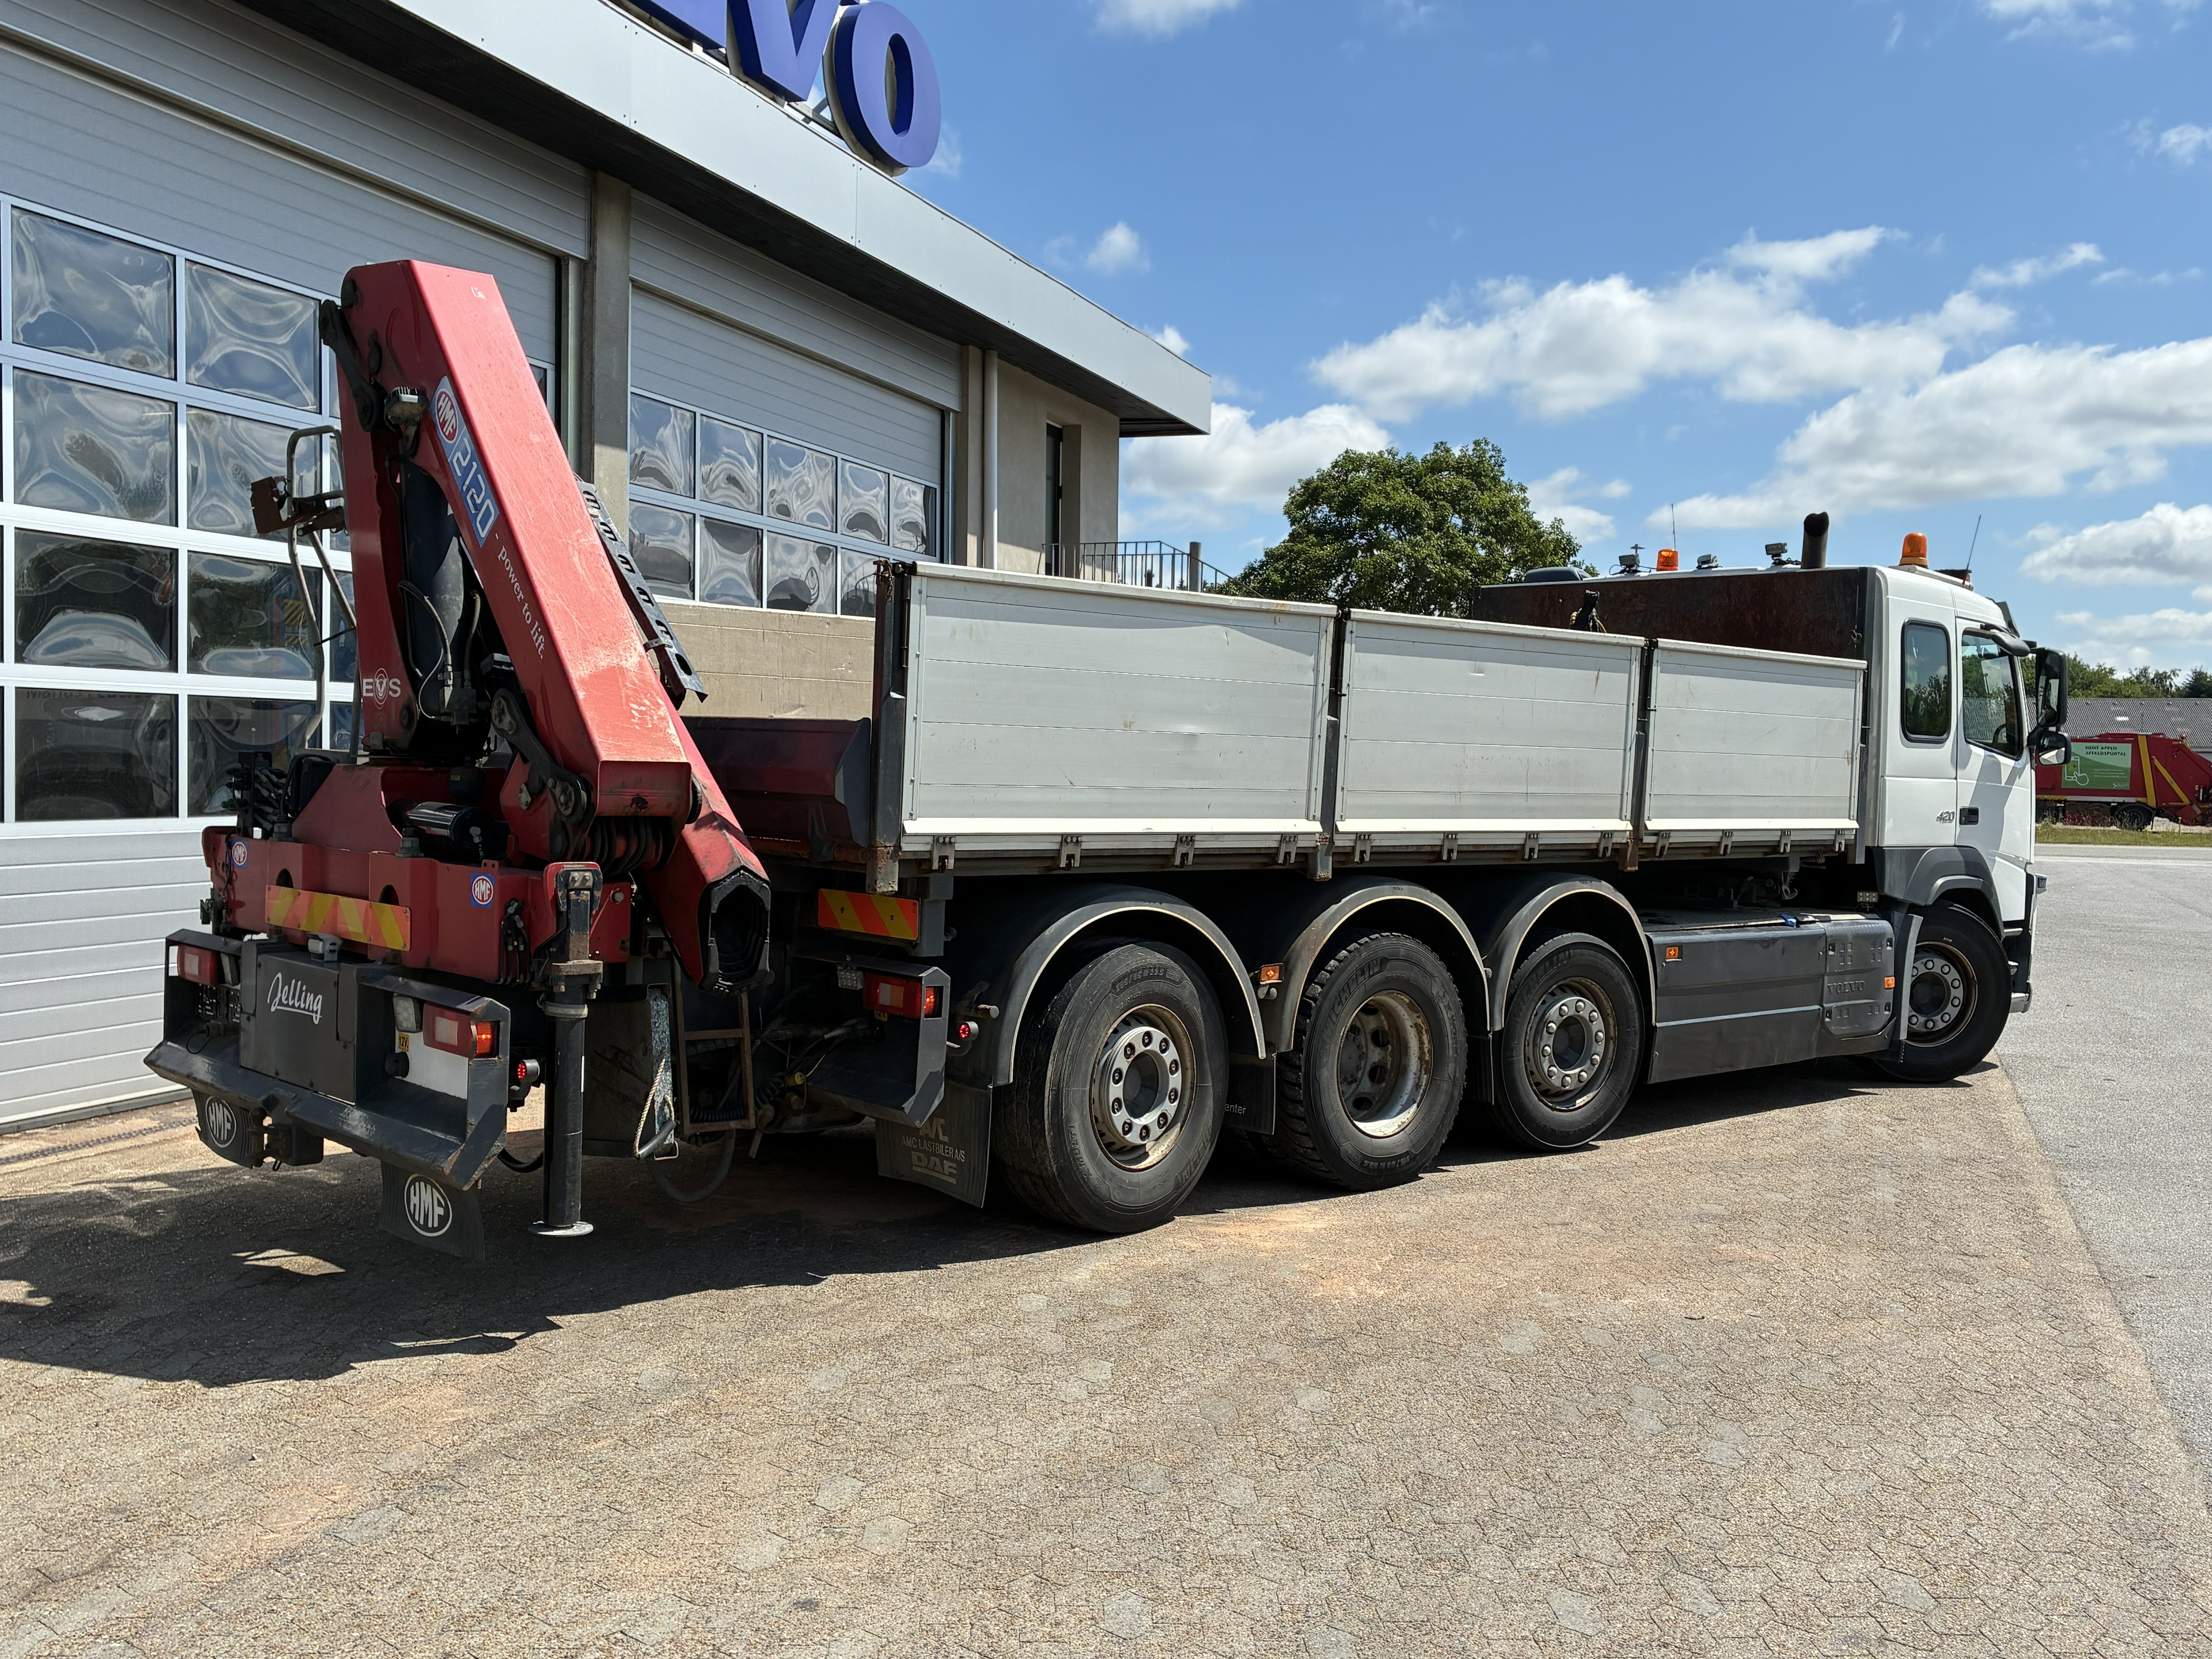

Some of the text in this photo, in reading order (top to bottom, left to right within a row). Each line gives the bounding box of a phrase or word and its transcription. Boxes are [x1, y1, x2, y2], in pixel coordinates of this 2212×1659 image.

[629, 0, 941, 168] VO
[437, 394, 456, 435] HMF
[453, 438, 494, 538] 2120
[498, 545, 524, 602] power
[522, 602, 532, 624] to
[530, 621, 545, 659] lift.
[1936, 810, 1955, 823] 420
[234, 844, 245, 862] HMF
[475, 879, 490, 901] HMF
[267, 972, 323, 1025] Jelling
[1827, 980, 1865, 994] VOLVO
[208, 1101, 232, 1141] HMF
[901, 1135, 965, 1162] AMC LASTBILER A/S
[911, 1151, 957, 1175] DAF
[410, 1181, 445, 1228] HMF
